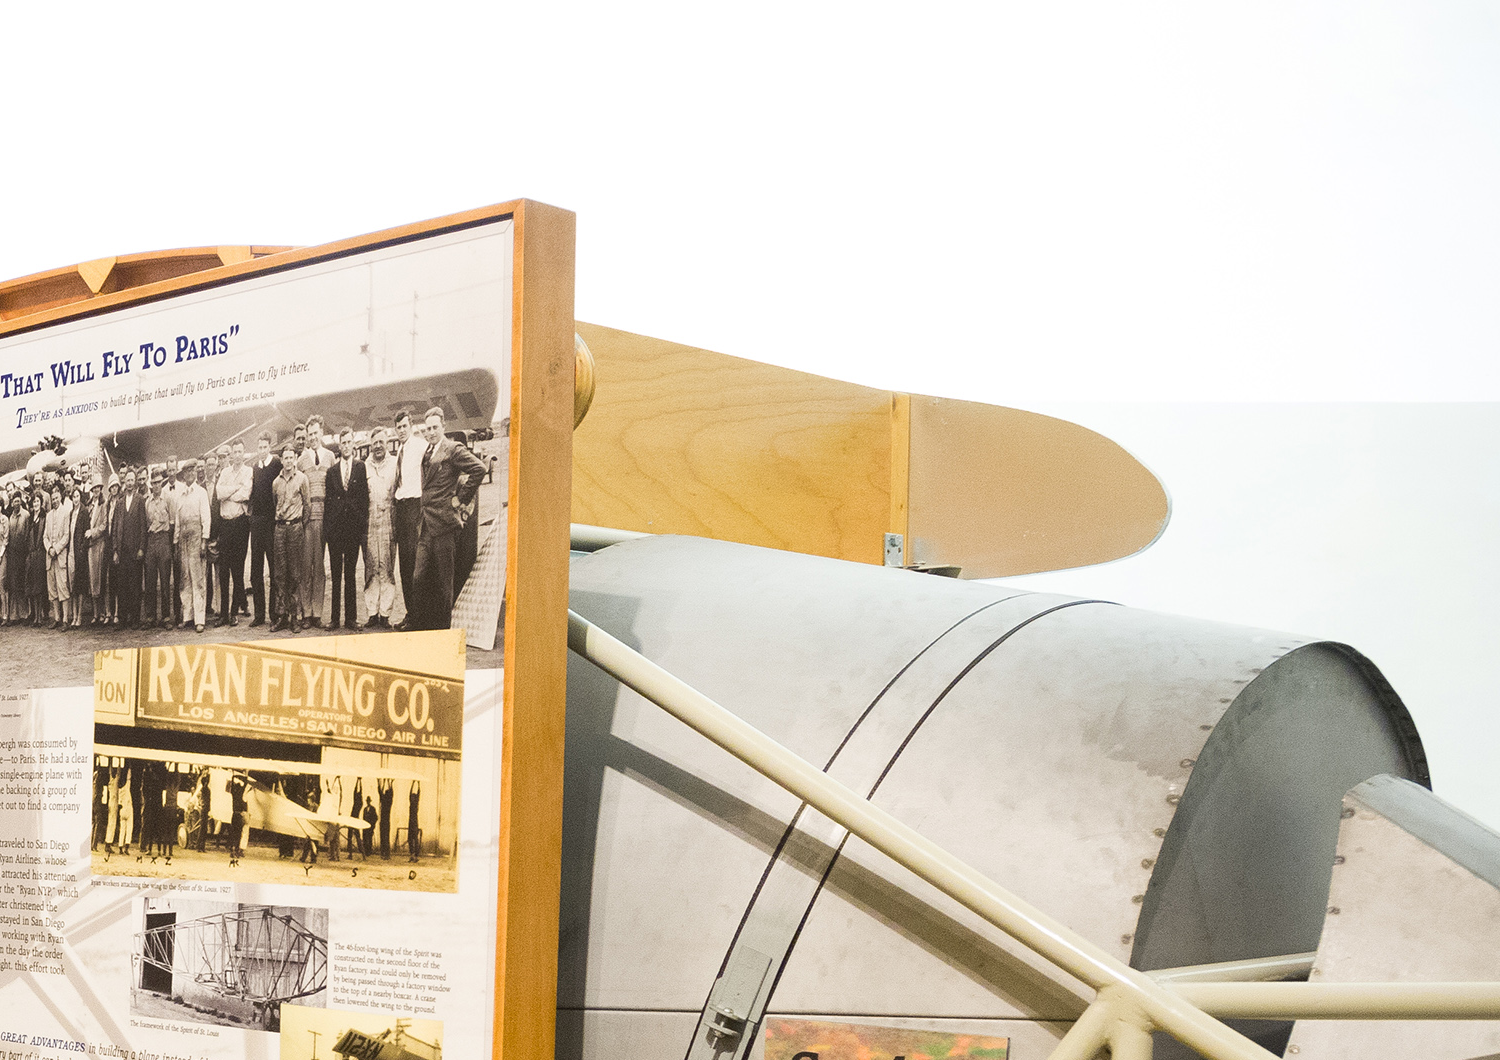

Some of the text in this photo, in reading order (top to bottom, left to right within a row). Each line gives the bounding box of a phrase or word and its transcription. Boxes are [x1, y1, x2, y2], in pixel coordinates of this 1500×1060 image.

[1, 373, 43, 398] THAT
[50, 360, 94, 388] WILL
[102, 351, 133, 378] FLY
[140, 343, 166, 370] TO
[53, 409, 63, 418] AS
[65, 401, 98, 417] ANXIOUS
[101, 399, 107, 410] to
[110, 395, 125, 408] build
[134, 389, 152, 405] plane
[155, 388, 168, 399] that
[171, 385, 183, 397] will
[184, 382, 194, 395] fly
[197, 381, 204, 392] to
[206, 377, 225, 390] Paris
[228, 377, 235, 386] as
[238, 372, 242, 384] I
[244, 373, 255, 382] am
[258, 371, 265, 380] to
[267, 366, 278, 382] fly
[280, 364, 286, 376] it
[289, 362, 309, 374] there.
[230, 397, 244, 405] Spirit
[245, 393, 251, 401] of
[148, 646, 434, 732] RYAN FLYING CO.
[179, 705, 449, 747] LOS ANGELES SAN DIEGO AIR LINE
[299, 709, 352, 722] OPERATORS
[32, 737, 67, 748] consumed
[69, 737, 77, 750] by
[0, 1032, 28, 1045] GREAT
[30, 1036, 85, 1052] ADVANTAGES
[89, 1042, 96, 1053] in
[99, 1043, 128, 1060] building
[131, 1052, 136, 1060] a
